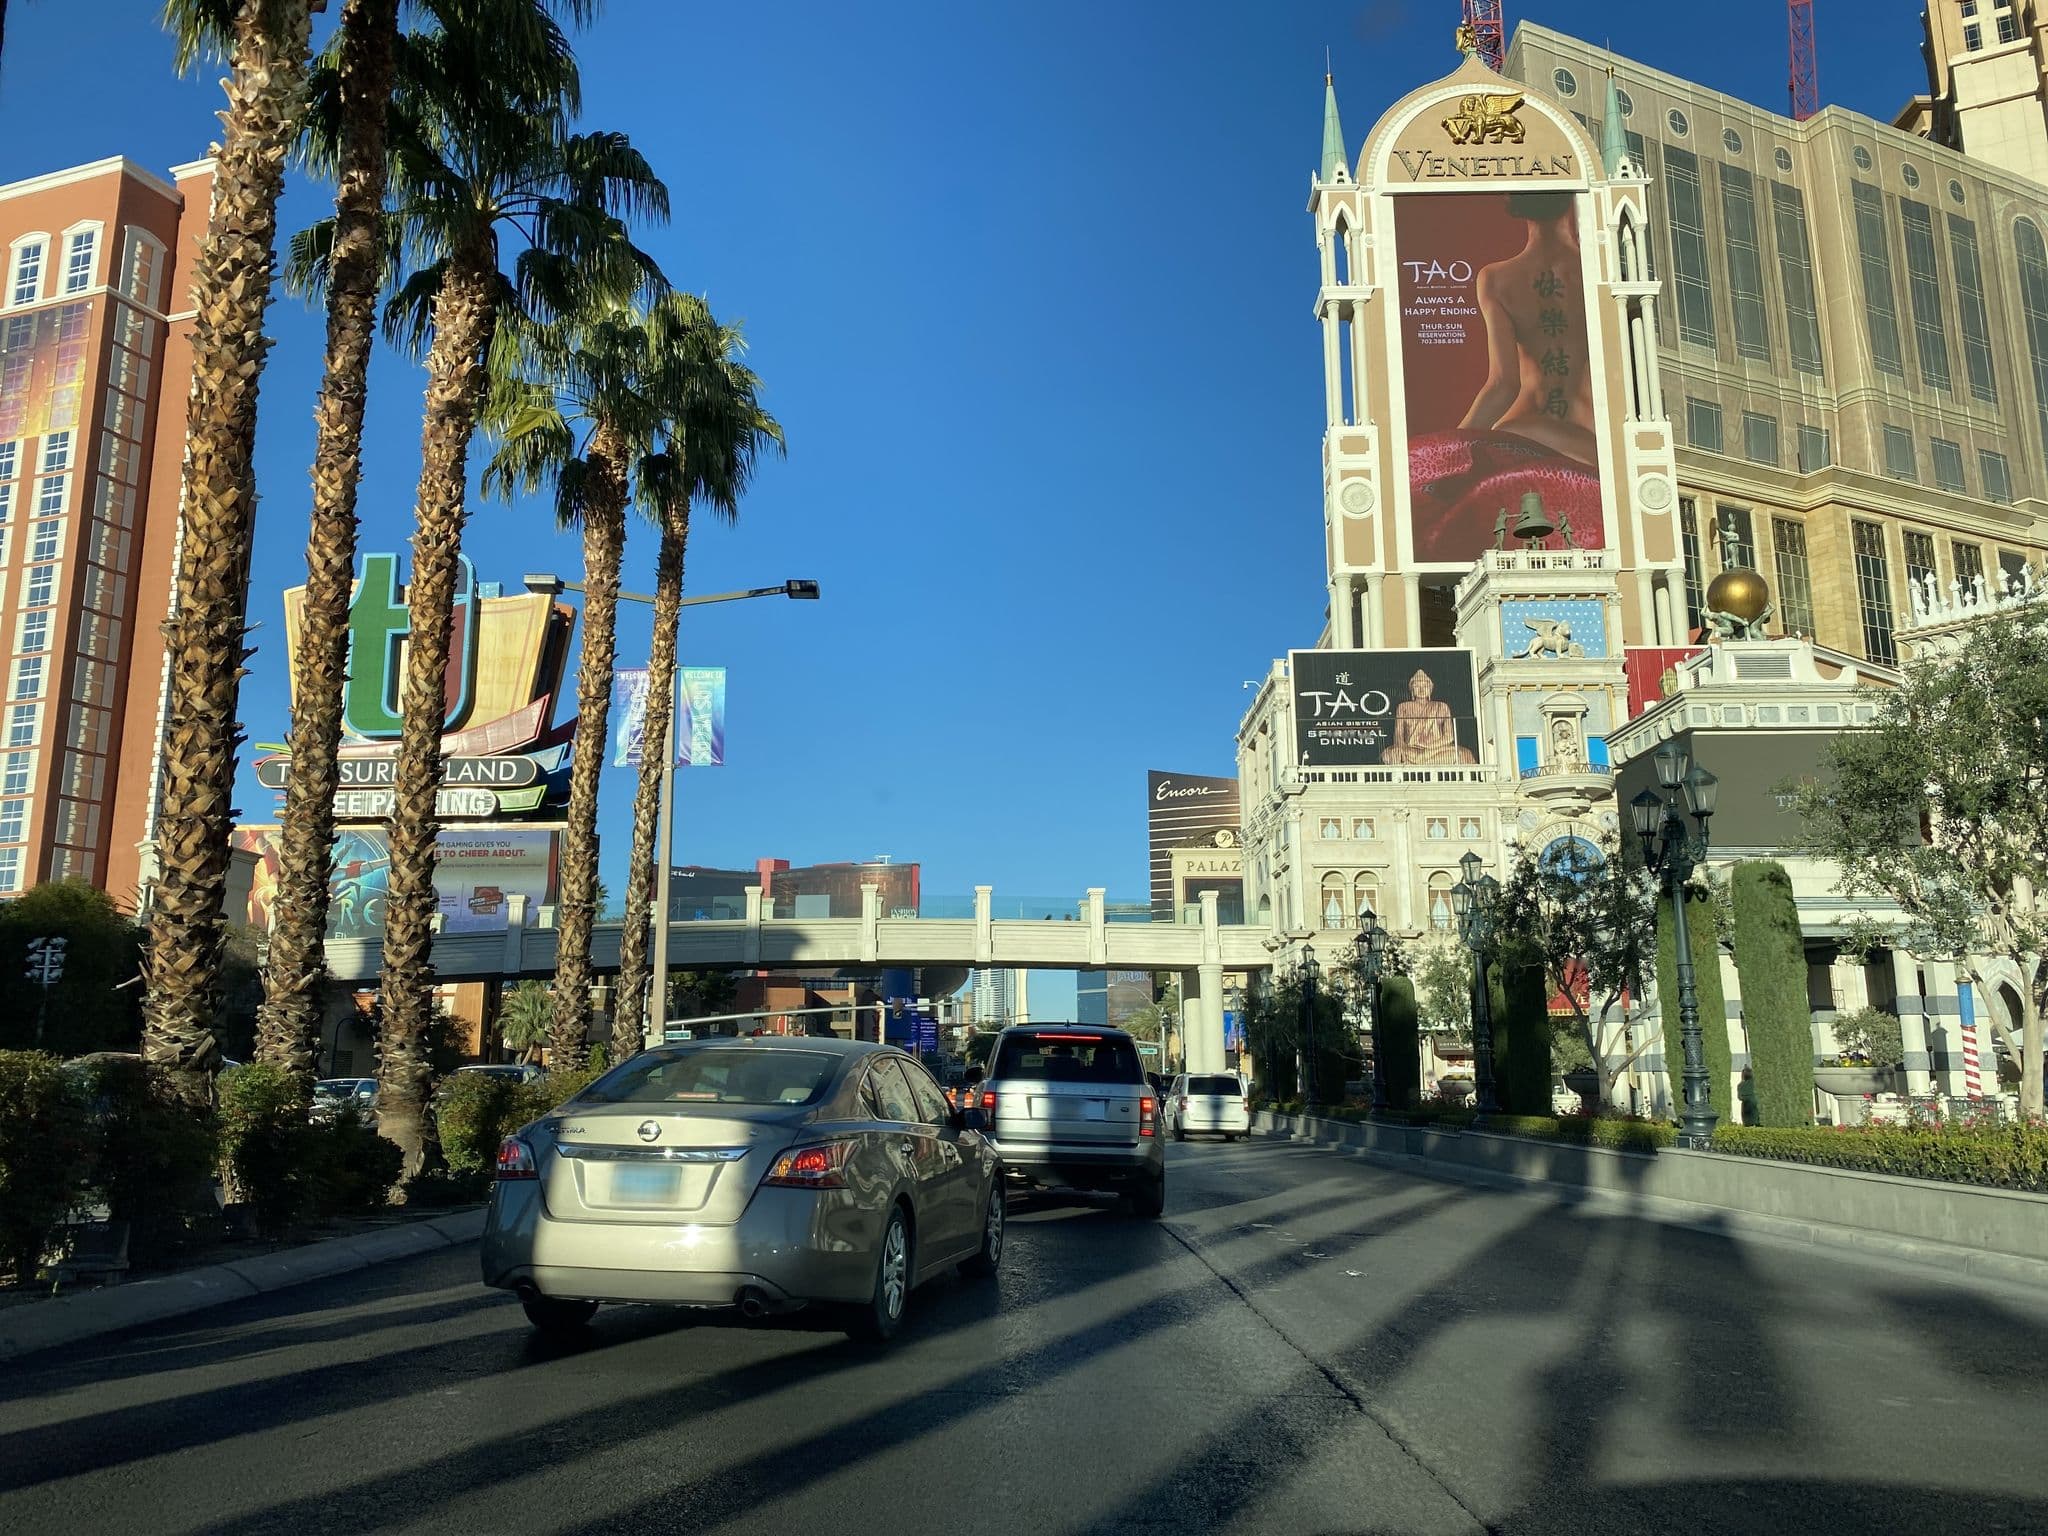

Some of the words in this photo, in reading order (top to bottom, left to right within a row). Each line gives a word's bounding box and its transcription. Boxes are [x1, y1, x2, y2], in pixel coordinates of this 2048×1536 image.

[1393, 150, 1573, 181] VENETIAN
[1402, 259, 1473, 284] TAO
[1415, 296, 1454, 304] ALWAYS
[1457, 296, 1466, 304] A
[1404, 307, 1437, 316] HAPPY
[1440, 307, 1478, 315] ENDING
[1320, 738, 1375, 746] DINING
[1156, 780, 1229, 801] Encore
[458, 849, 489, 857] CHEER
[491, 849, 526, 858] ABOUT.
